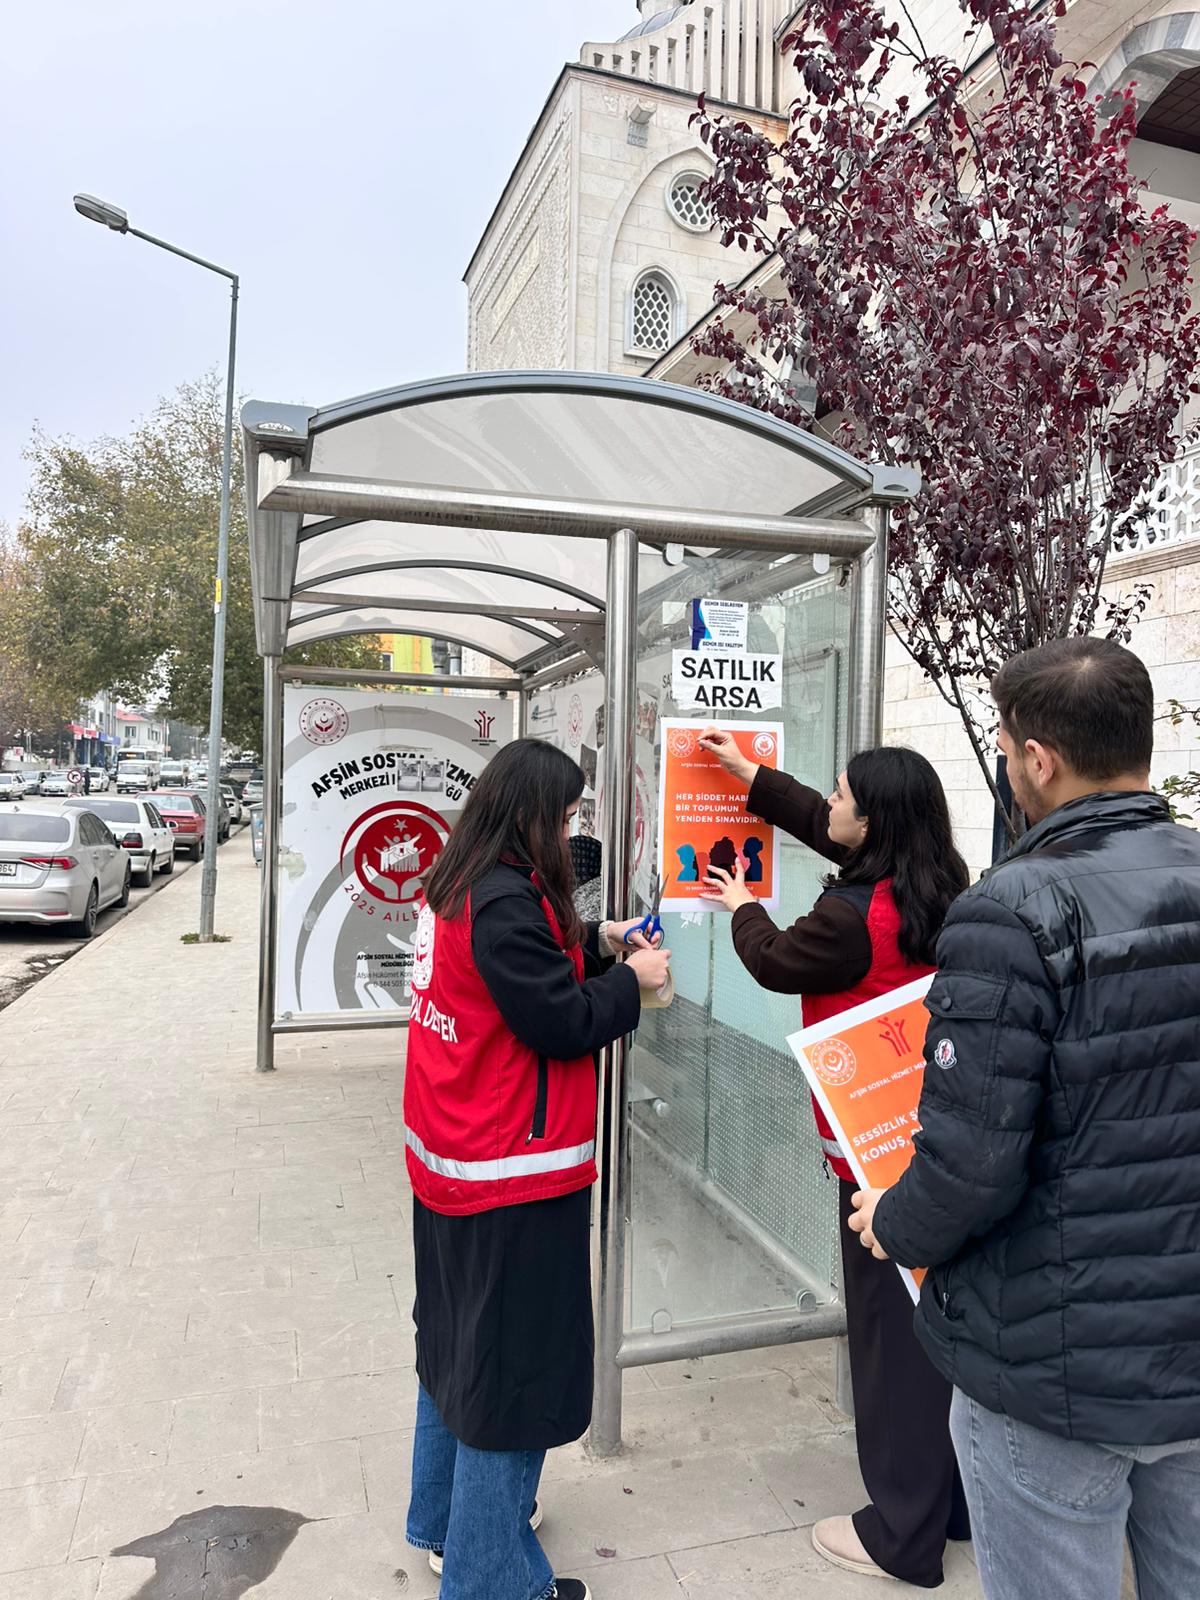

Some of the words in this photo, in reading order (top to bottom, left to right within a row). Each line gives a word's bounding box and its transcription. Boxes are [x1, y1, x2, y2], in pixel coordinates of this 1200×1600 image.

[681, 657, 775, 682] SATILIK
[694, 685, 762, 709] ARSA
[311, 760, 361, 798] AFŞİN
[339, 772, 391, 799] MERKEZİ
[696, 793, 726, 801] ŞİDDET
[344, 884, 376, 915] 2025
[852, 1114, 908, 1147] SESSİZLİK
[860, 1135, 910, 1163] KONUŞ,
